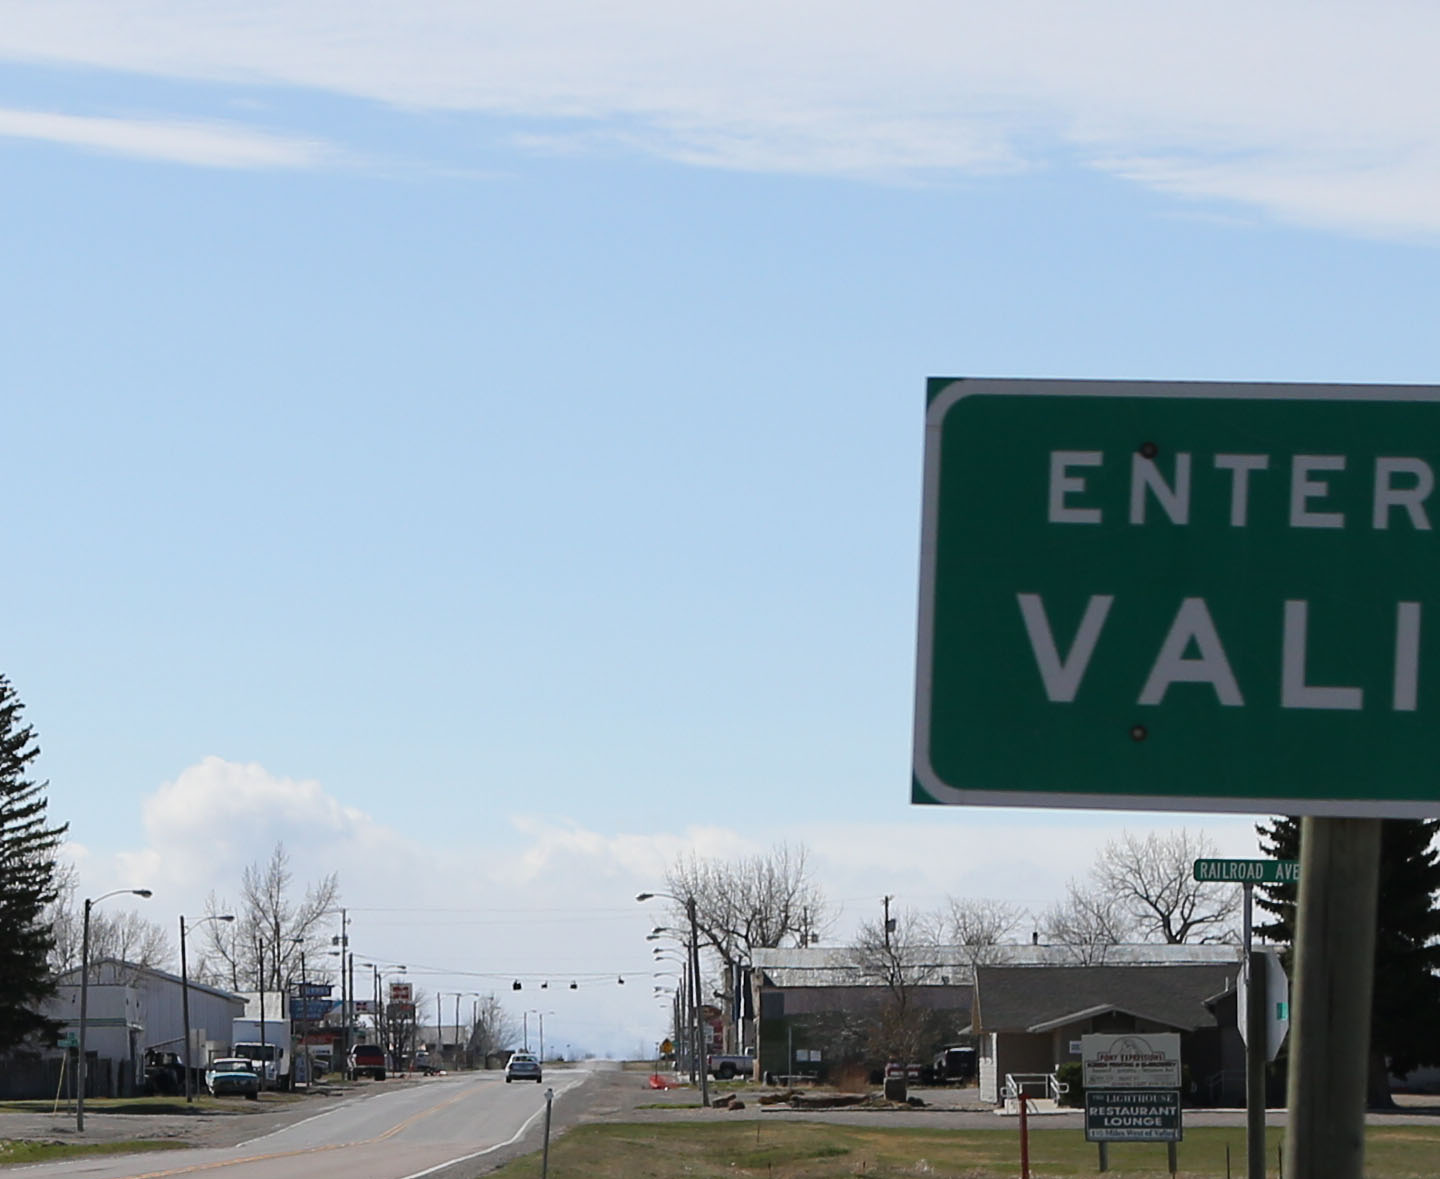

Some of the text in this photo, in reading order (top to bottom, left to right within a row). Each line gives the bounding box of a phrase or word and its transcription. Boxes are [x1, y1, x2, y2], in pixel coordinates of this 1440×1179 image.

[1200, 862, 1301, 881] RAILROAD AVE
[1106, 1094, 1173, 1103] LIGHTHOUSE
[1089, 1106, 1177, 1116] RESTAURANT
[1104, 1117, 1163, 1126] LOUNGE
